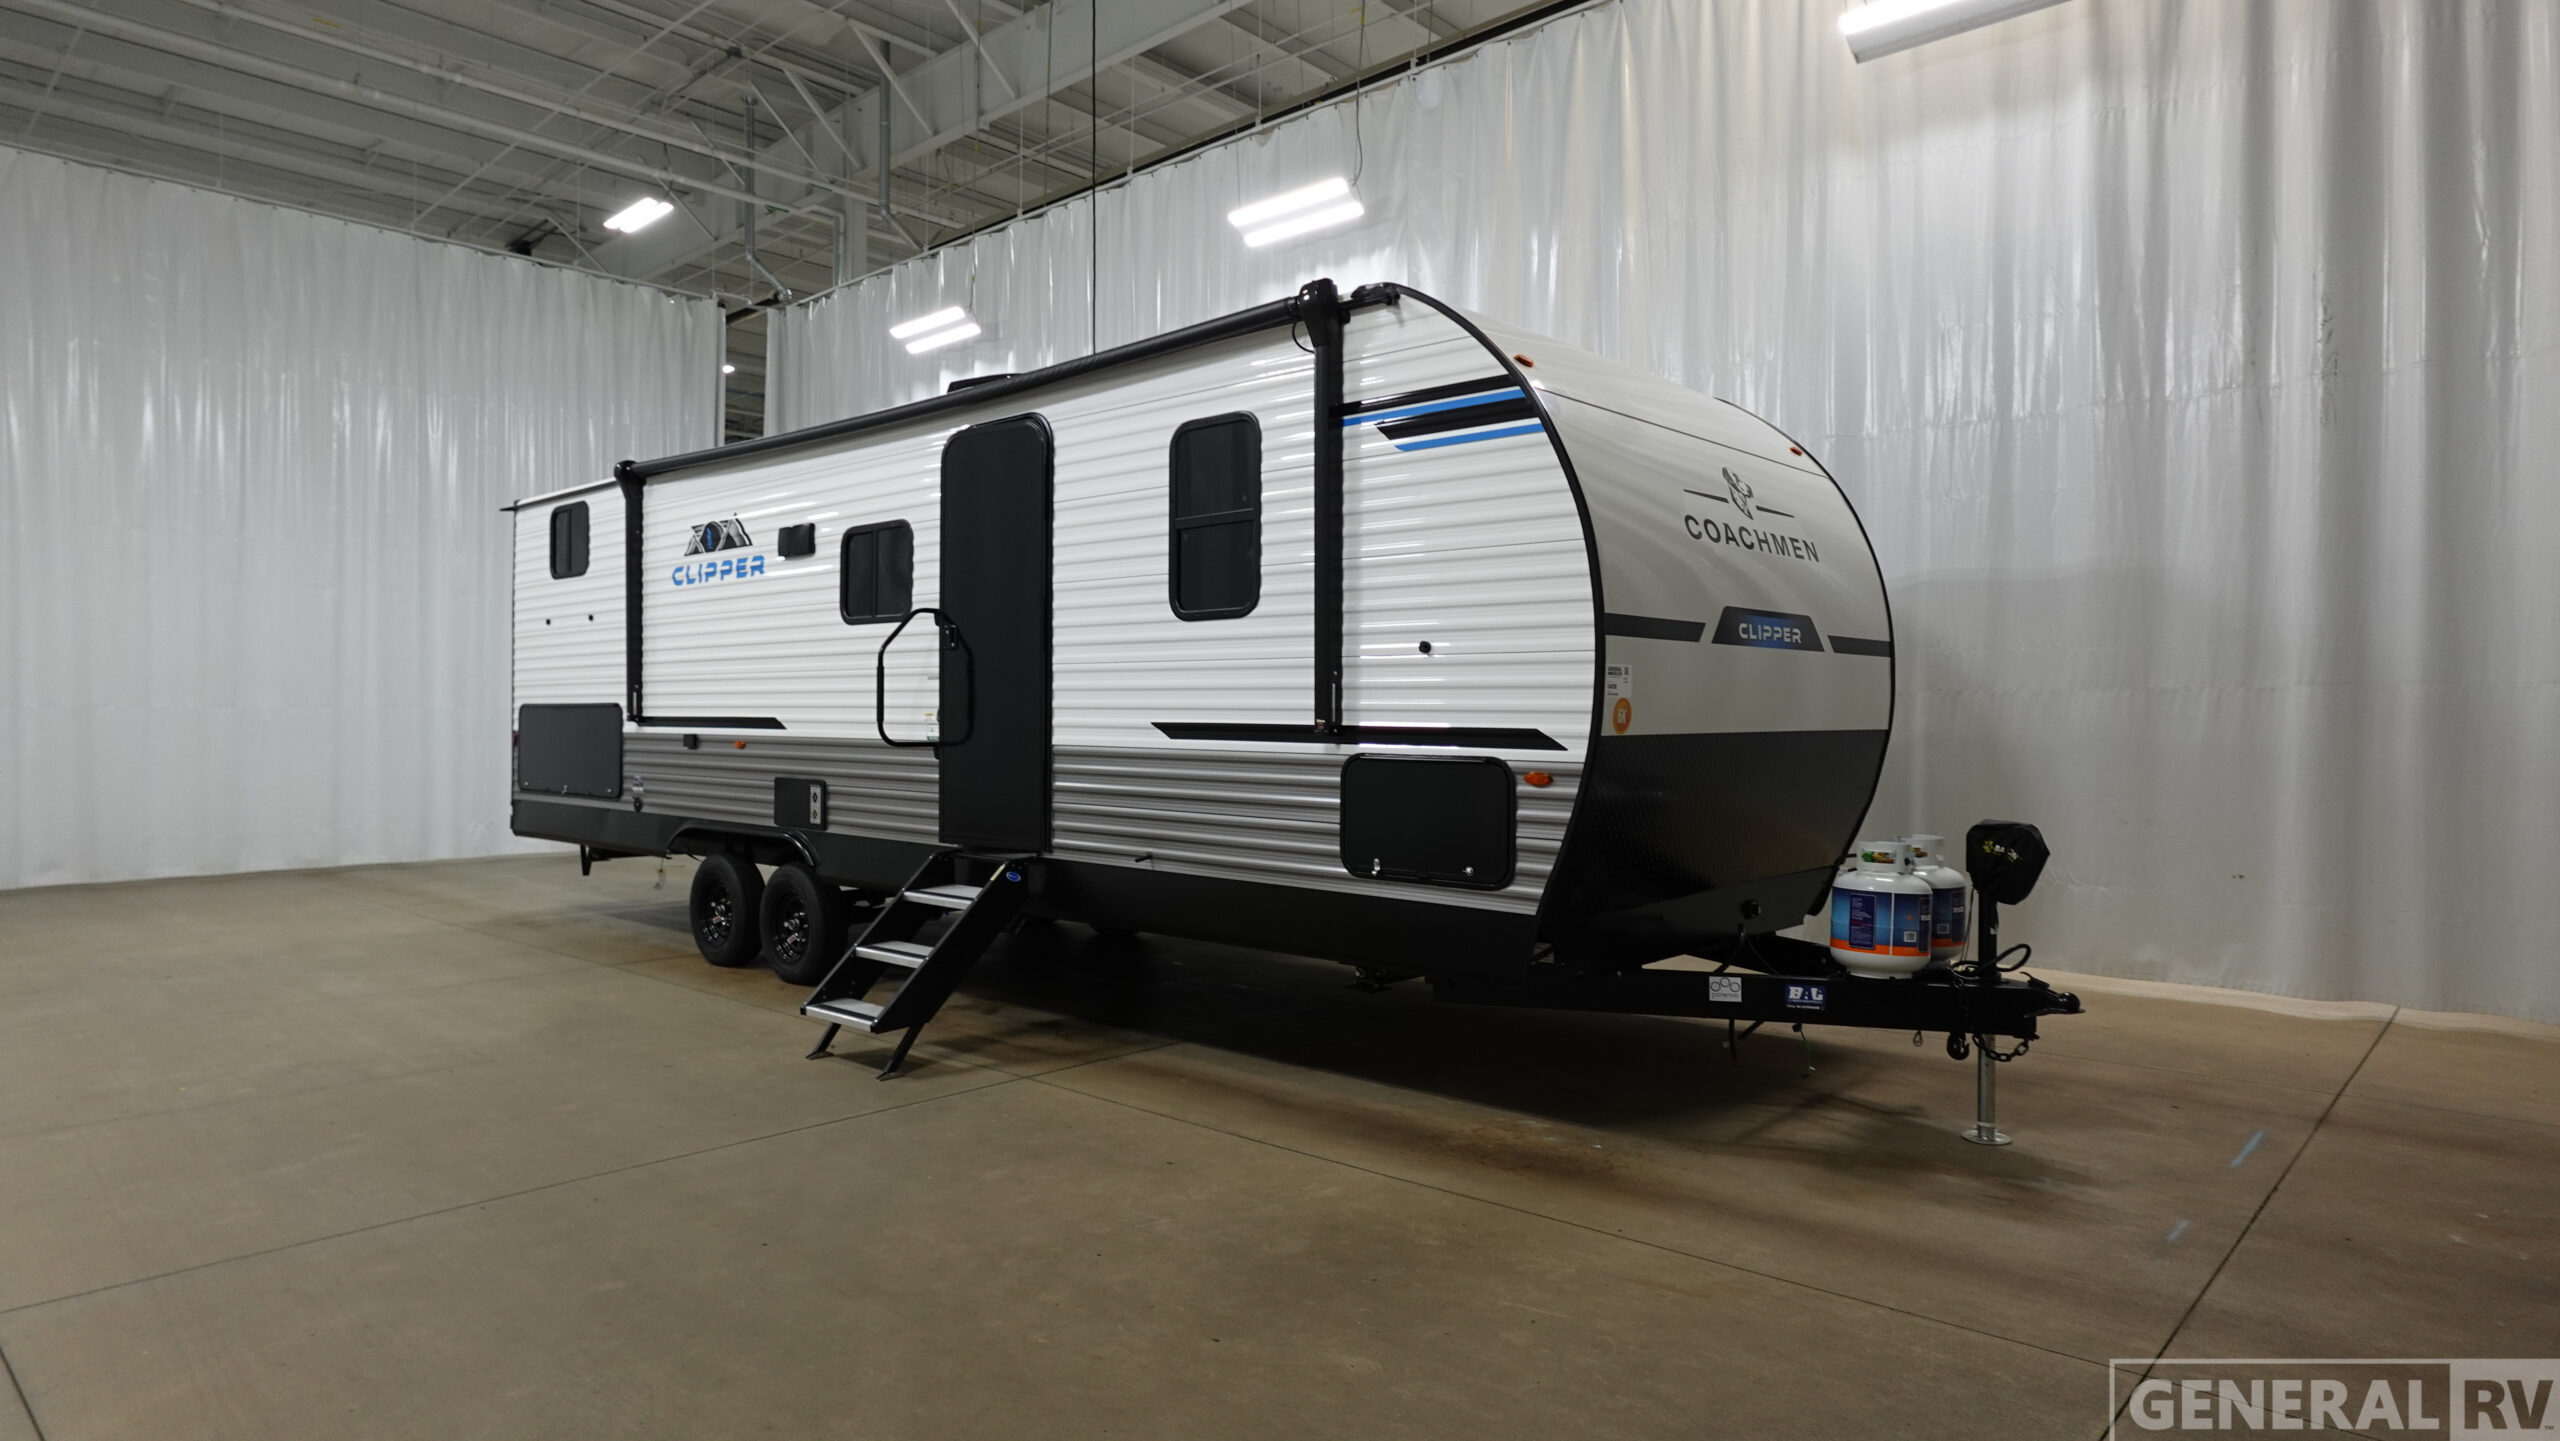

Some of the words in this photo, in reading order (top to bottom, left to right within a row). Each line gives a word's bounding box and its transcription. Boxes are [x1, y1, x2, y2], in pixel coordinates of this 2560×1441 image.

[1684, 514, 1820, 563] COACHMEN
[671, 555, 765, 586] CLIPPER
[1738, 622, 1802, 643] CLIPPER
